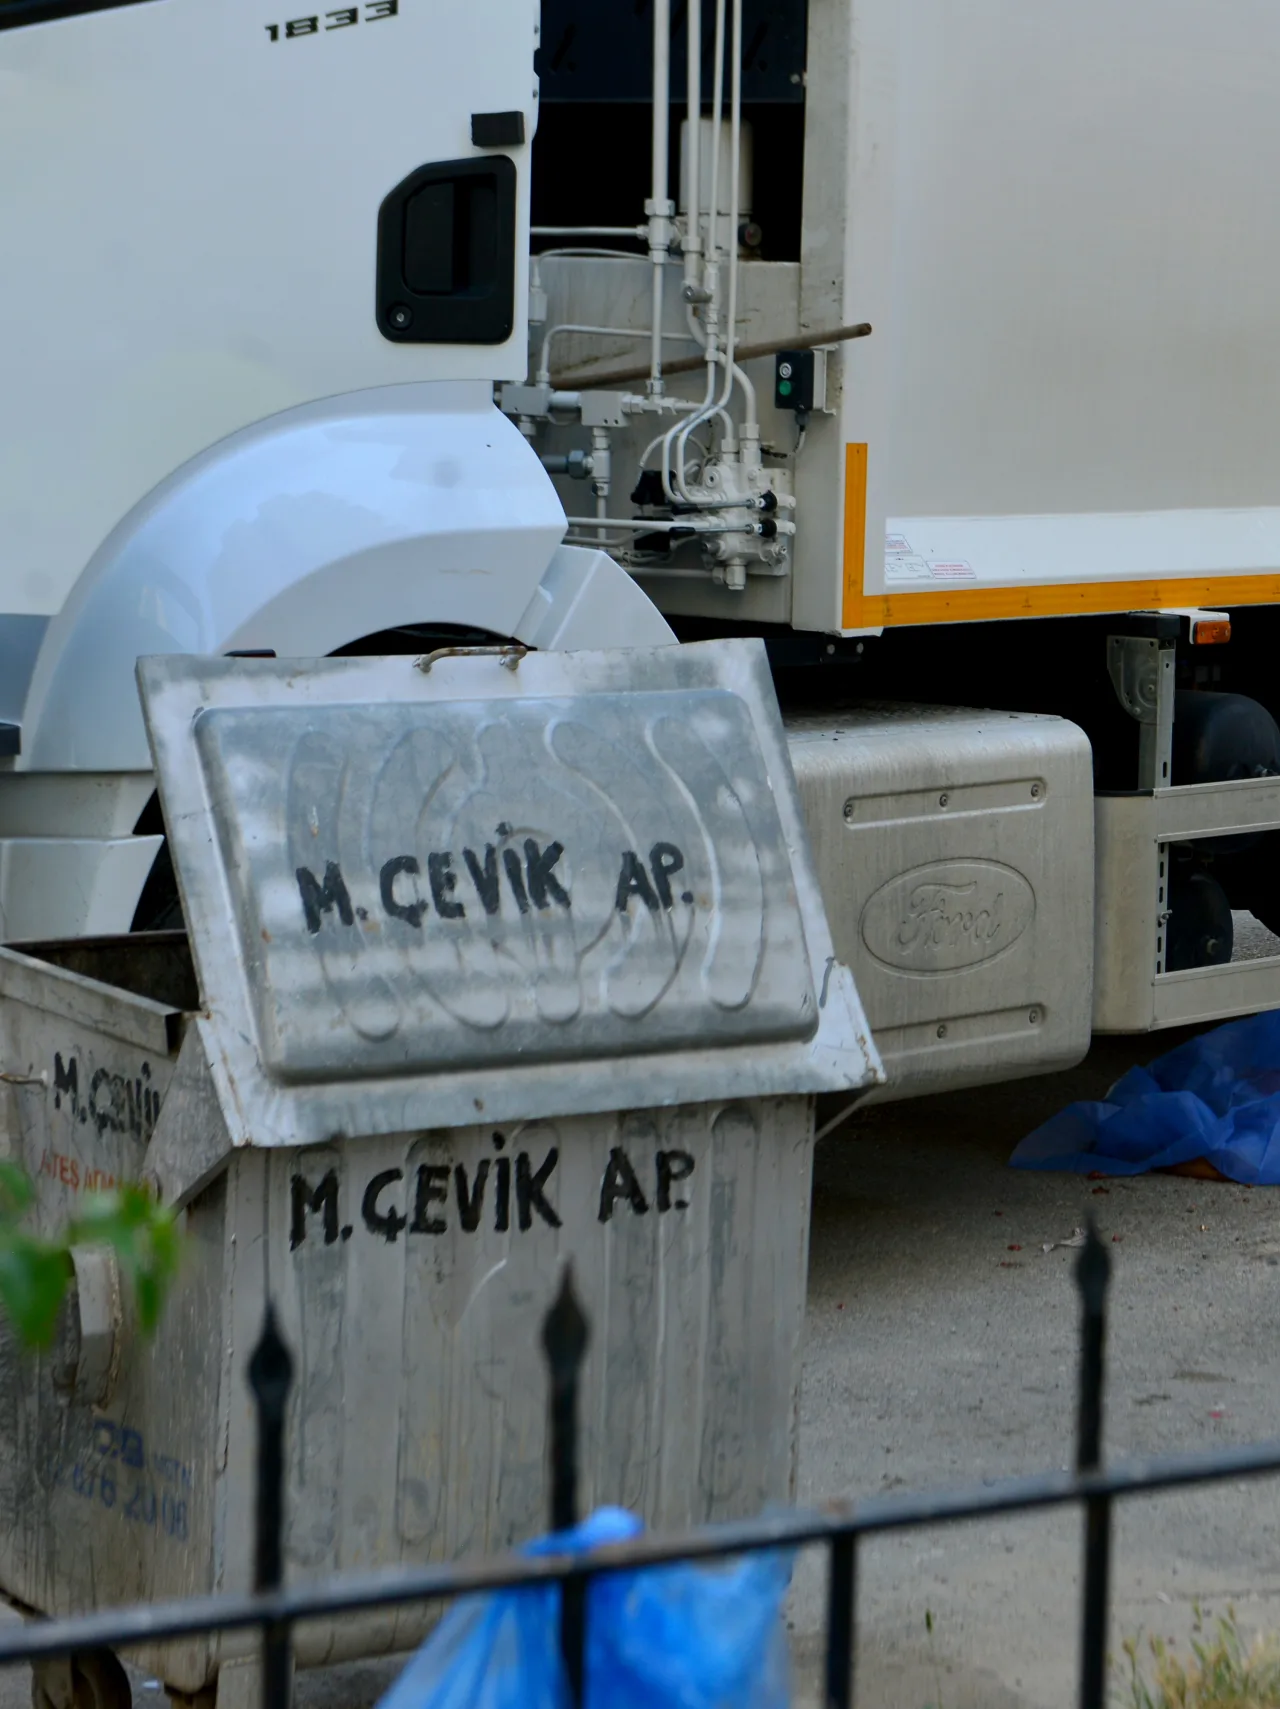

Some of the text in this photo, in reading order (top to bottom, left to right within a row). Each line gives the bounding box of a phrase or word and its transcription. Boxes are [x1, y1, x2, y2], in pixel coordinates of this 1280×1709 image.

[265, 0, 399, 42] 1833
[615, 841, 694, 912] AP.
[898, 880, 1004, 956] Ford
[598, 1146, 695, 1224] AP.
